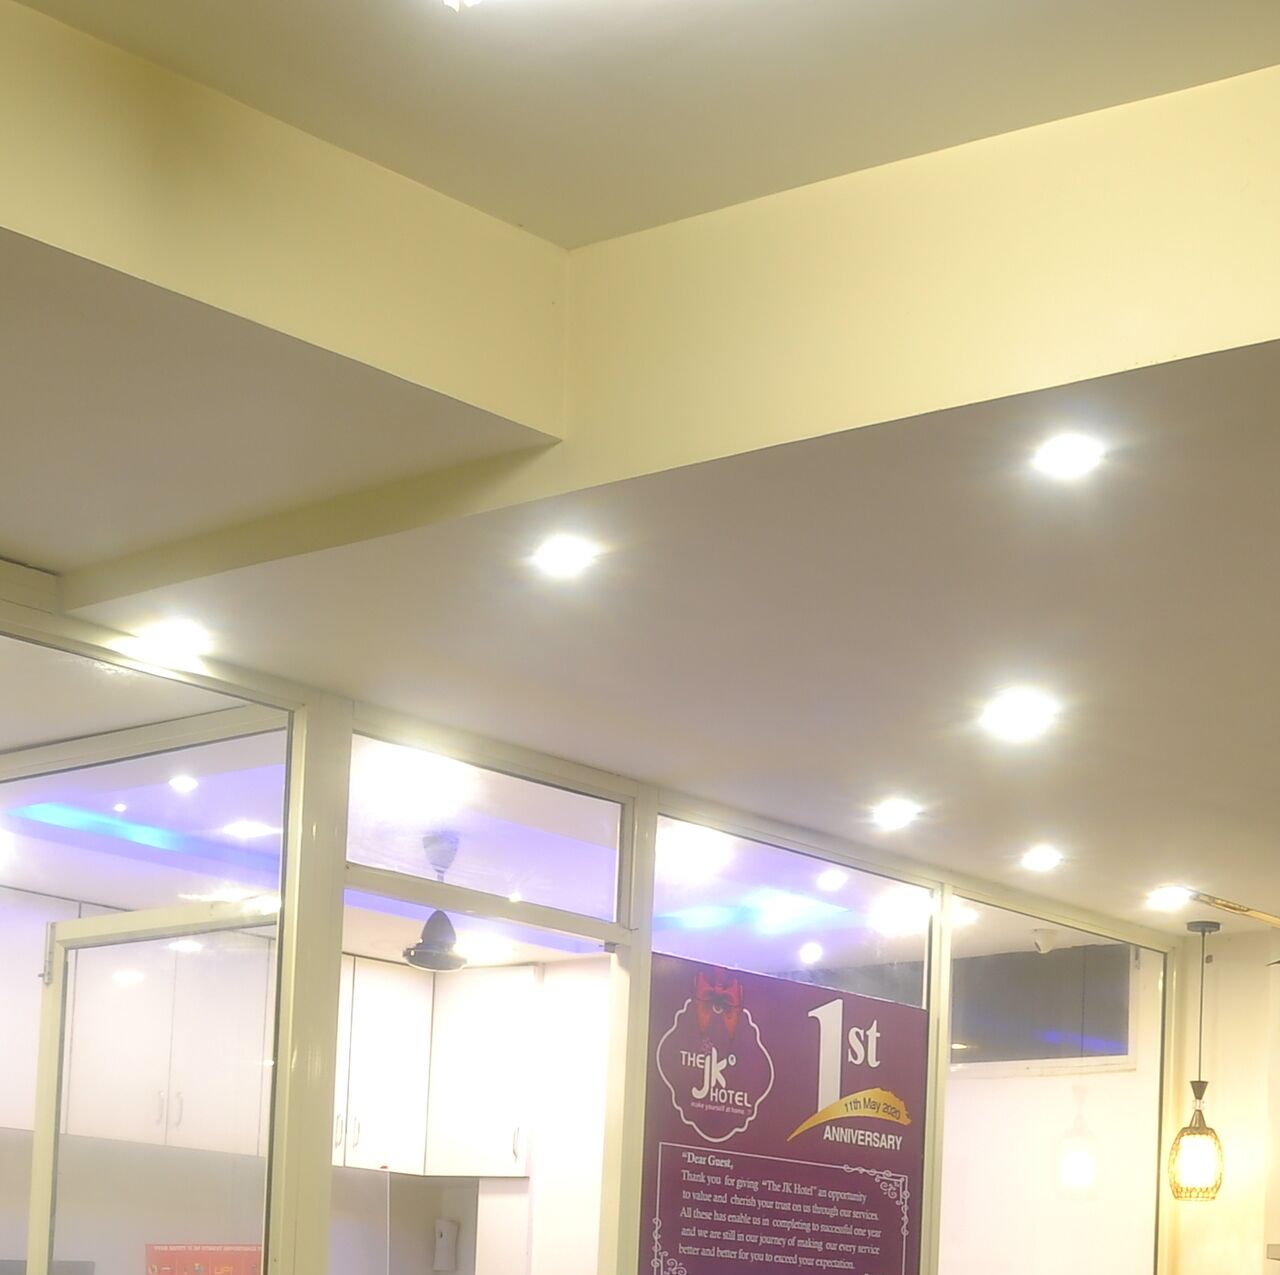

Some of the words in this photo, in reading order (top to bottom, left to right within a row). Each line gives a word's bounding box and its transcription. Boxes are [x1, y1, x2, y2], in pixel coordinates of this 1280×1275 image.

[680, 1050, 705, 1069] THE
[710, 1088, 752, 1108] HOTEL
[844, 1098, 862, 1113] 11th
[863, 1097, 881, 1113] May
[882, 1103, 901, 1120] 2020
[823, 1125, 903, 1151] ANNIVERSARY
[681, 1169, 706, 1183] Thank
[707, 1175, 721, 1186] you
[724, 1174, 736, 1186] for
[736, 1177, 759, 1192] giving
[782, 1182, 792, 1194] JK
[818, 1189, 826, 1198] an
[828, 1190, 867, 1205] opportunity
[682, 1190, 691, 1199] to
[692, 1191, 713, 1202] value
[713, 1193, 727, 1204] and
[730, 1194, 756, 1207] cherish
[757, 1200, 774, 1210] your
[775, 1201, 791, 1211] trust
[792, 1203, 802, 1212] on
[803, 1204, 811, 1213] us
[812, 1204, 838, 1218] through
[840, 1208, 852, 1217] our
[680, 1206, 692, 1218] All
[693, 1208, 712, 1220] these
[714, 1210, 727, 1221] has
[728, 1212, 751, 1224] enable
[752, 1216, 761, 1226] us
[762, 1216, 769, 1226] in
[772, 1218, 811, 1233] completing
[811, 1222, 820, 1231] to
[854, 1227, 867, 1236] one
[867, 1229, 882, 1239] year
[681, 1226, 696, 1237] and
[697, 1229, 708, 1238] we
[710, 1230, 721, 1239] are
[723, 1229, 736, 1241] still
[737, 1231, 745, 1241] in
[746, 1233, 758, 1242] our
[758, 1233, 786, 1248] journey
[787, 1236, 796, 1246] of
[797, 1238, 823, 1252] making
[825, 1241, 838, 1251] our
[839, 1243, 856, 1254] every
[857, 1244, 880, 1255] service
